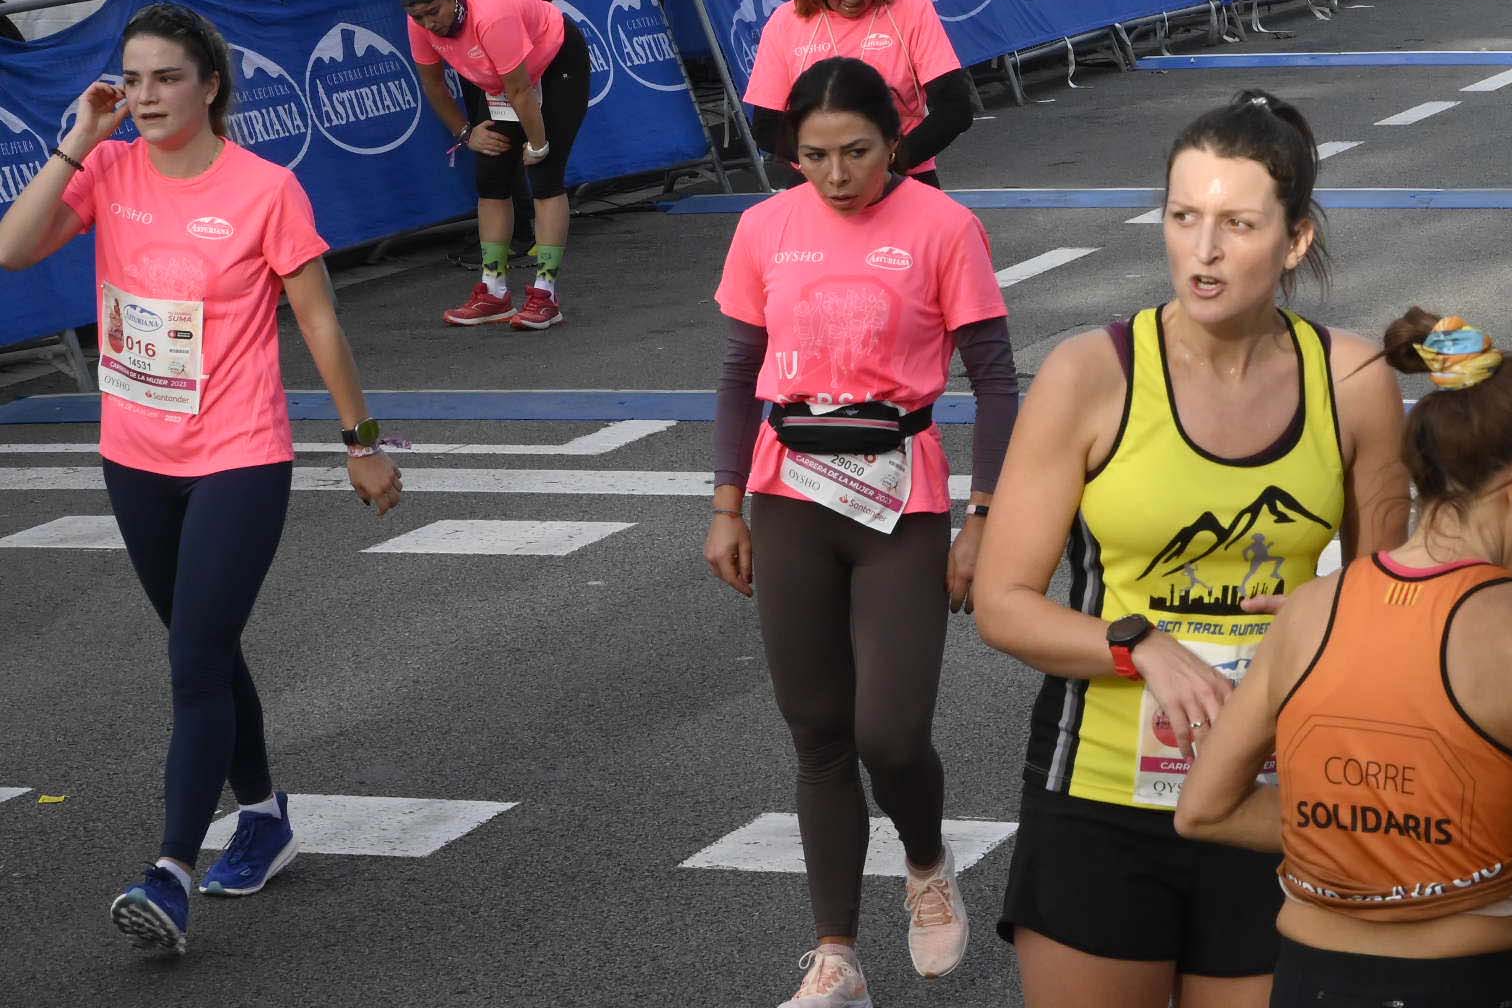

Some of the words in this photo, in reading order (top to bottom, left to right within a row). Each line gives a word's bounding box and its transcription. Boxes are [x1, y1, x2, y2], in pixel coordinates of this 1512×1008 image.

[326, 70, 362, 86] CENTRAL
[363, 61, 401, 80] LECHERA
[315, 77, 417, 129] ASTURIANA
[1, 139, 35, 156] ECHERA
[111, 203, 153, 225] OYSHO
[774, 250, 824, 265] OYSHO
[127, 355, 152, 372] 14531
[775, 350, 799, 380] TU
[152, 391, 192, 405] Santander
[795, 454, 827, 476] CARRERA
[828, 469, 839, 480] DE
[838, 474, 849, 485] LA
[849, 478, 875, 497] MUJER
[830, 453, 865, 478] 29030
[788, 468, 822, 492] OYSHO
[1156, 619, 1184, 634] BCN
[1186, 621, 1225, 636] TRAIL
[1325, 755, 1416, 795] CORRE
[1297, 800, 1454, 845] SOLIDARIS
